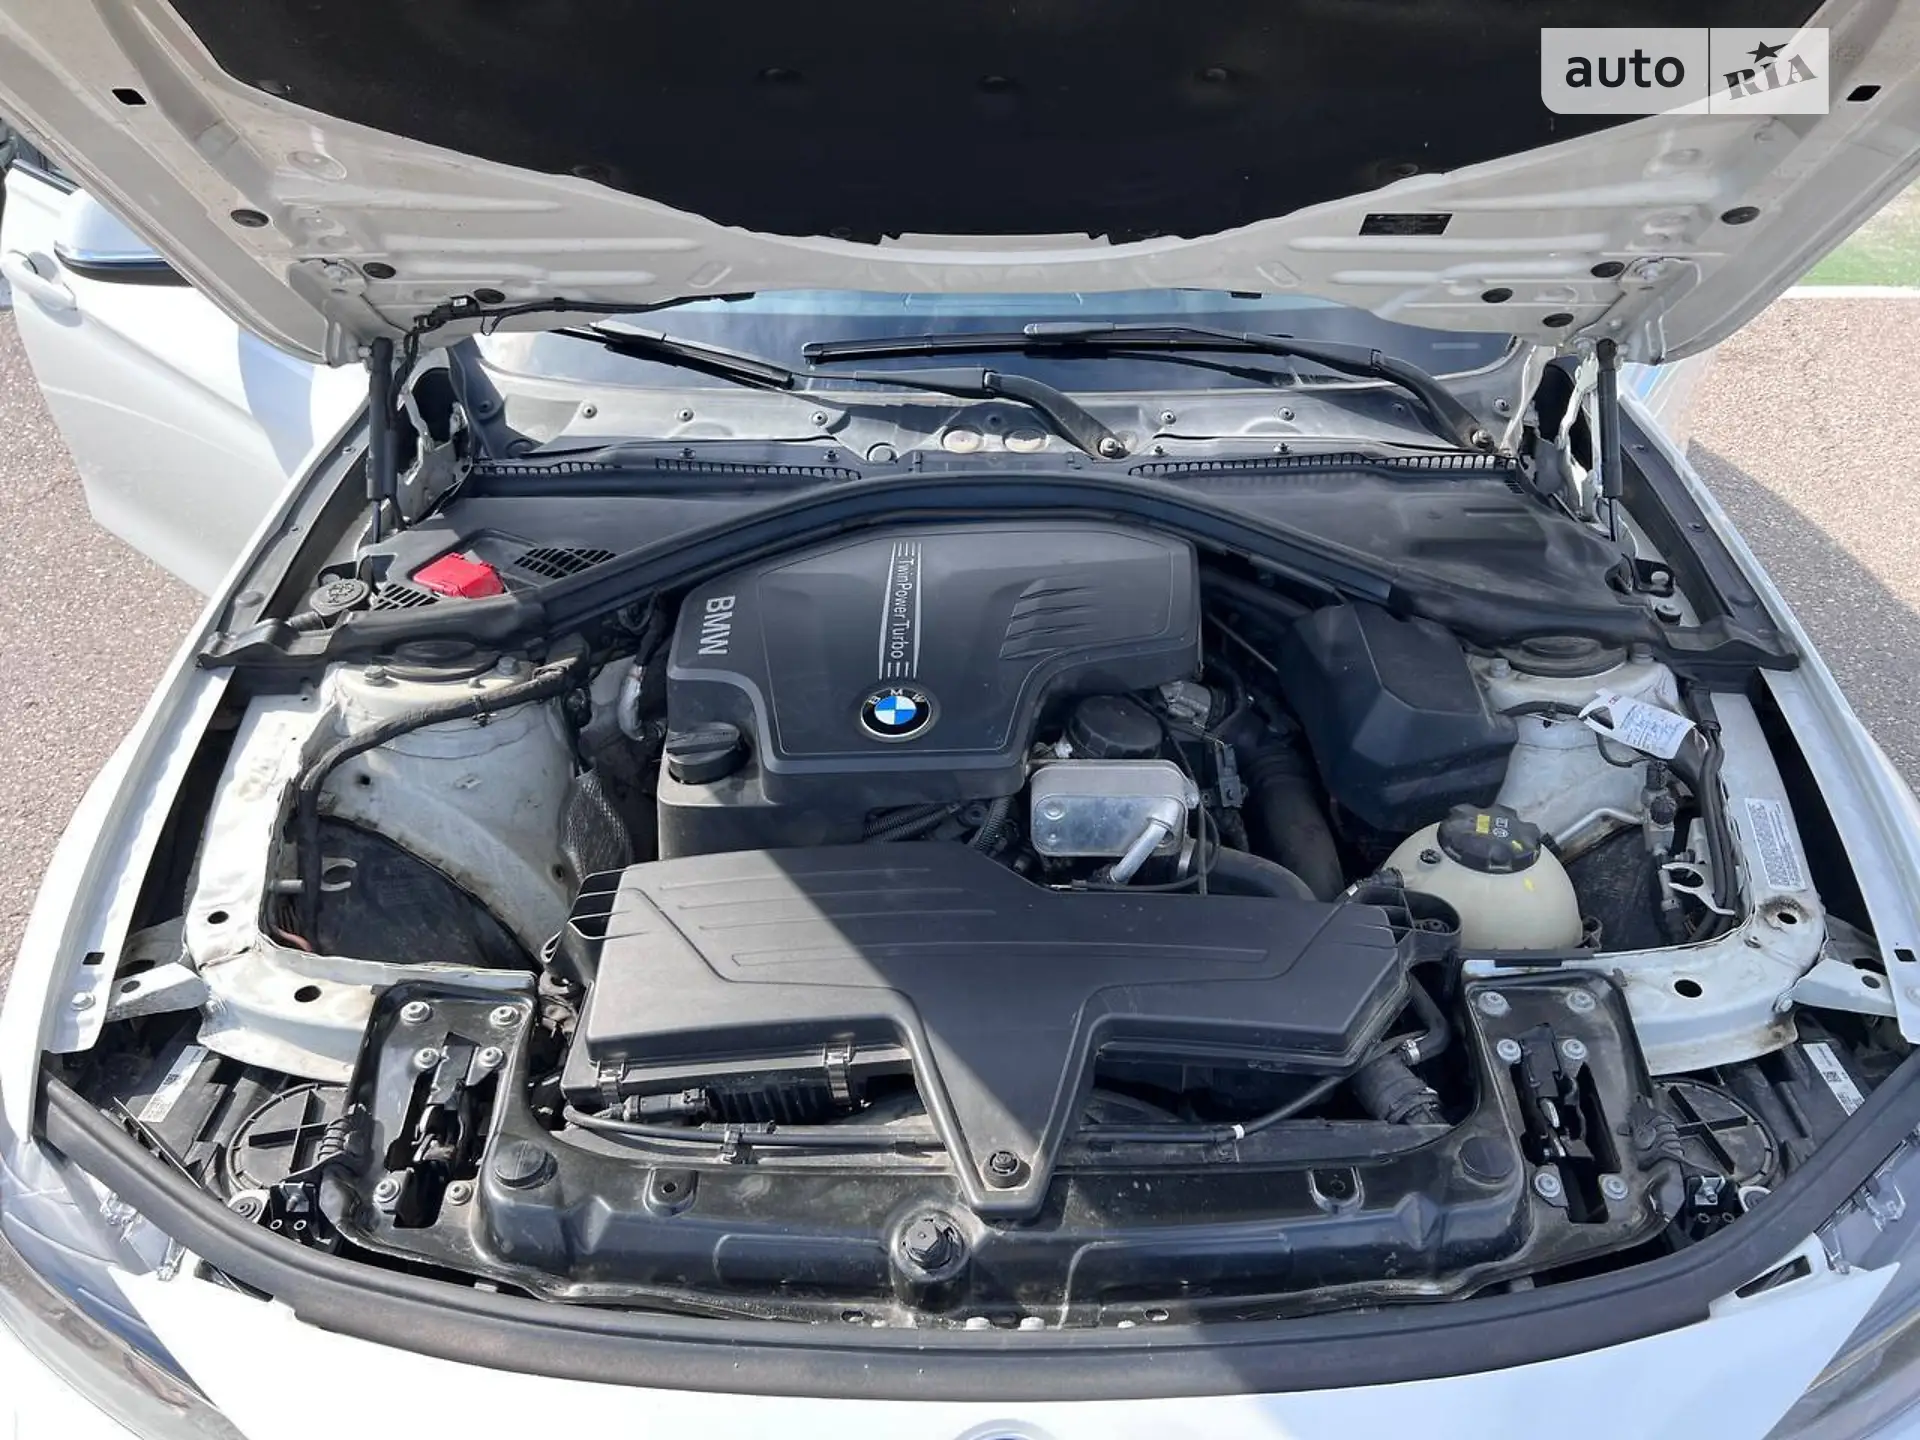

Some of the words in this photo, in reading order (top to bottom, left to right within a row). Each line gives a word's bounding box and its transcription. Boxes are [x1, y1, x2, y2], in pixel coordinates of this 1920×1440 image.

[893, 558, 914, 618] TwinPower
[698, 595, 735, 655] BMW
[891, 619, 910, 659] Turbo
[868, 688, 927, 704] BMW
